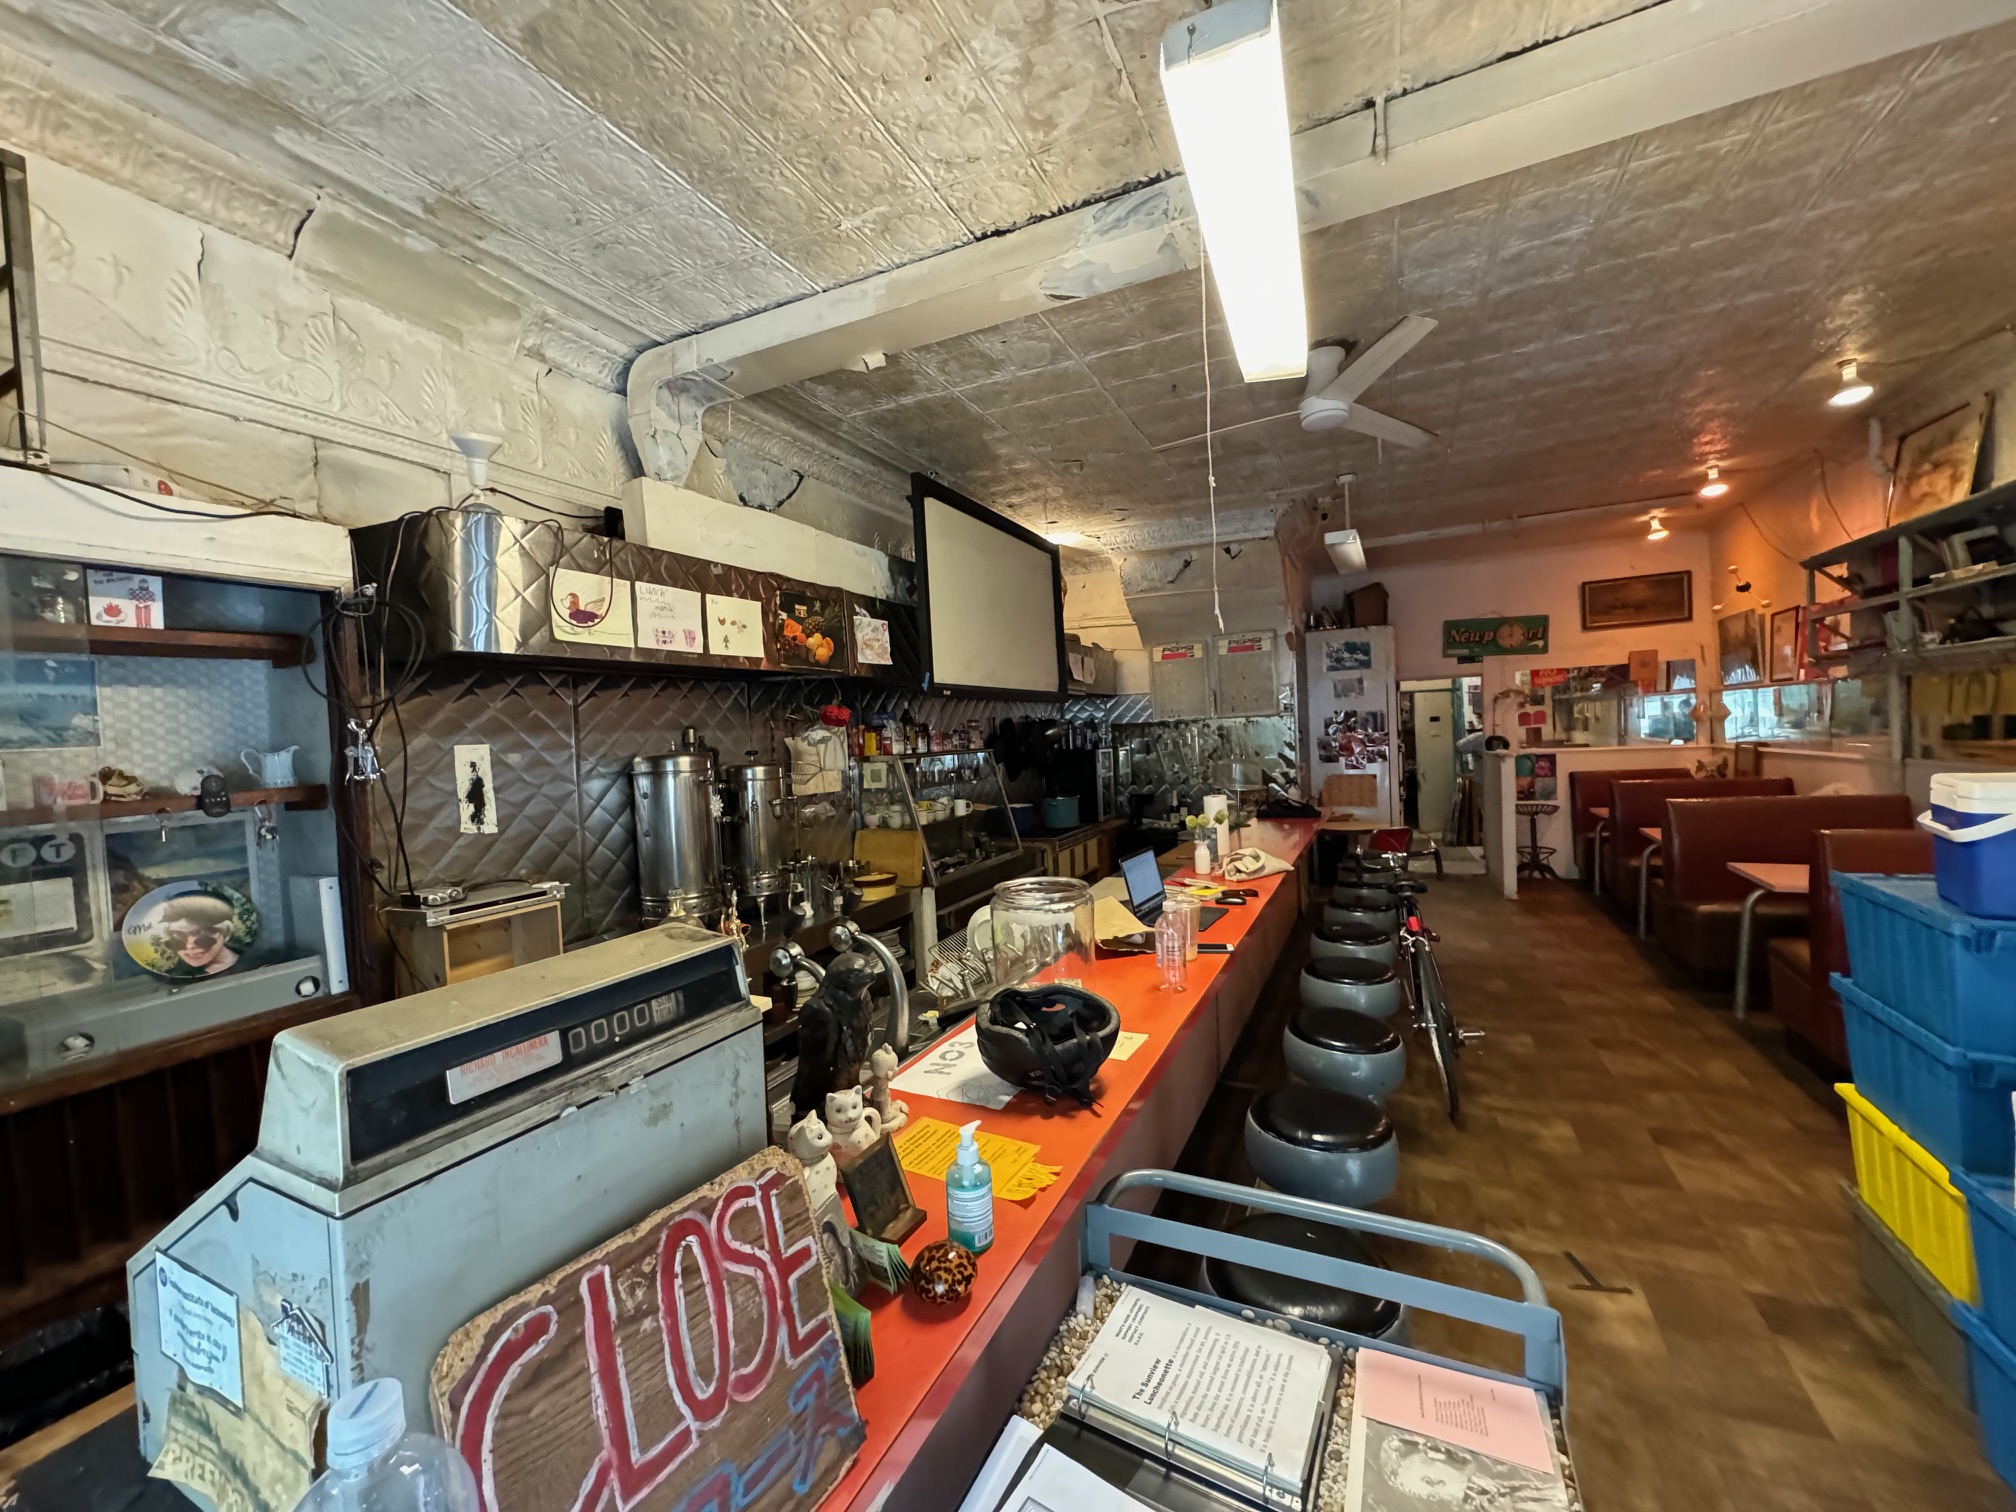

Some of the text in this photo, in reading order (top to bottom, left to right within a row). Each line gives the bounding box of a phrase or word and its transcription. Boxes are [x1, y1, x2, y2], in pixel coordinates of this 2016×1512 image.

[1228, 637, 1262, 646] PEPSI
[1449, 623, 1544, 647] Newprt
[1162, 645, 1195, 653] PEPSI
[1132, 1356, 1162, 1401] The Sunview
[1142, 1356, 1174, 1406] Luncheonette
